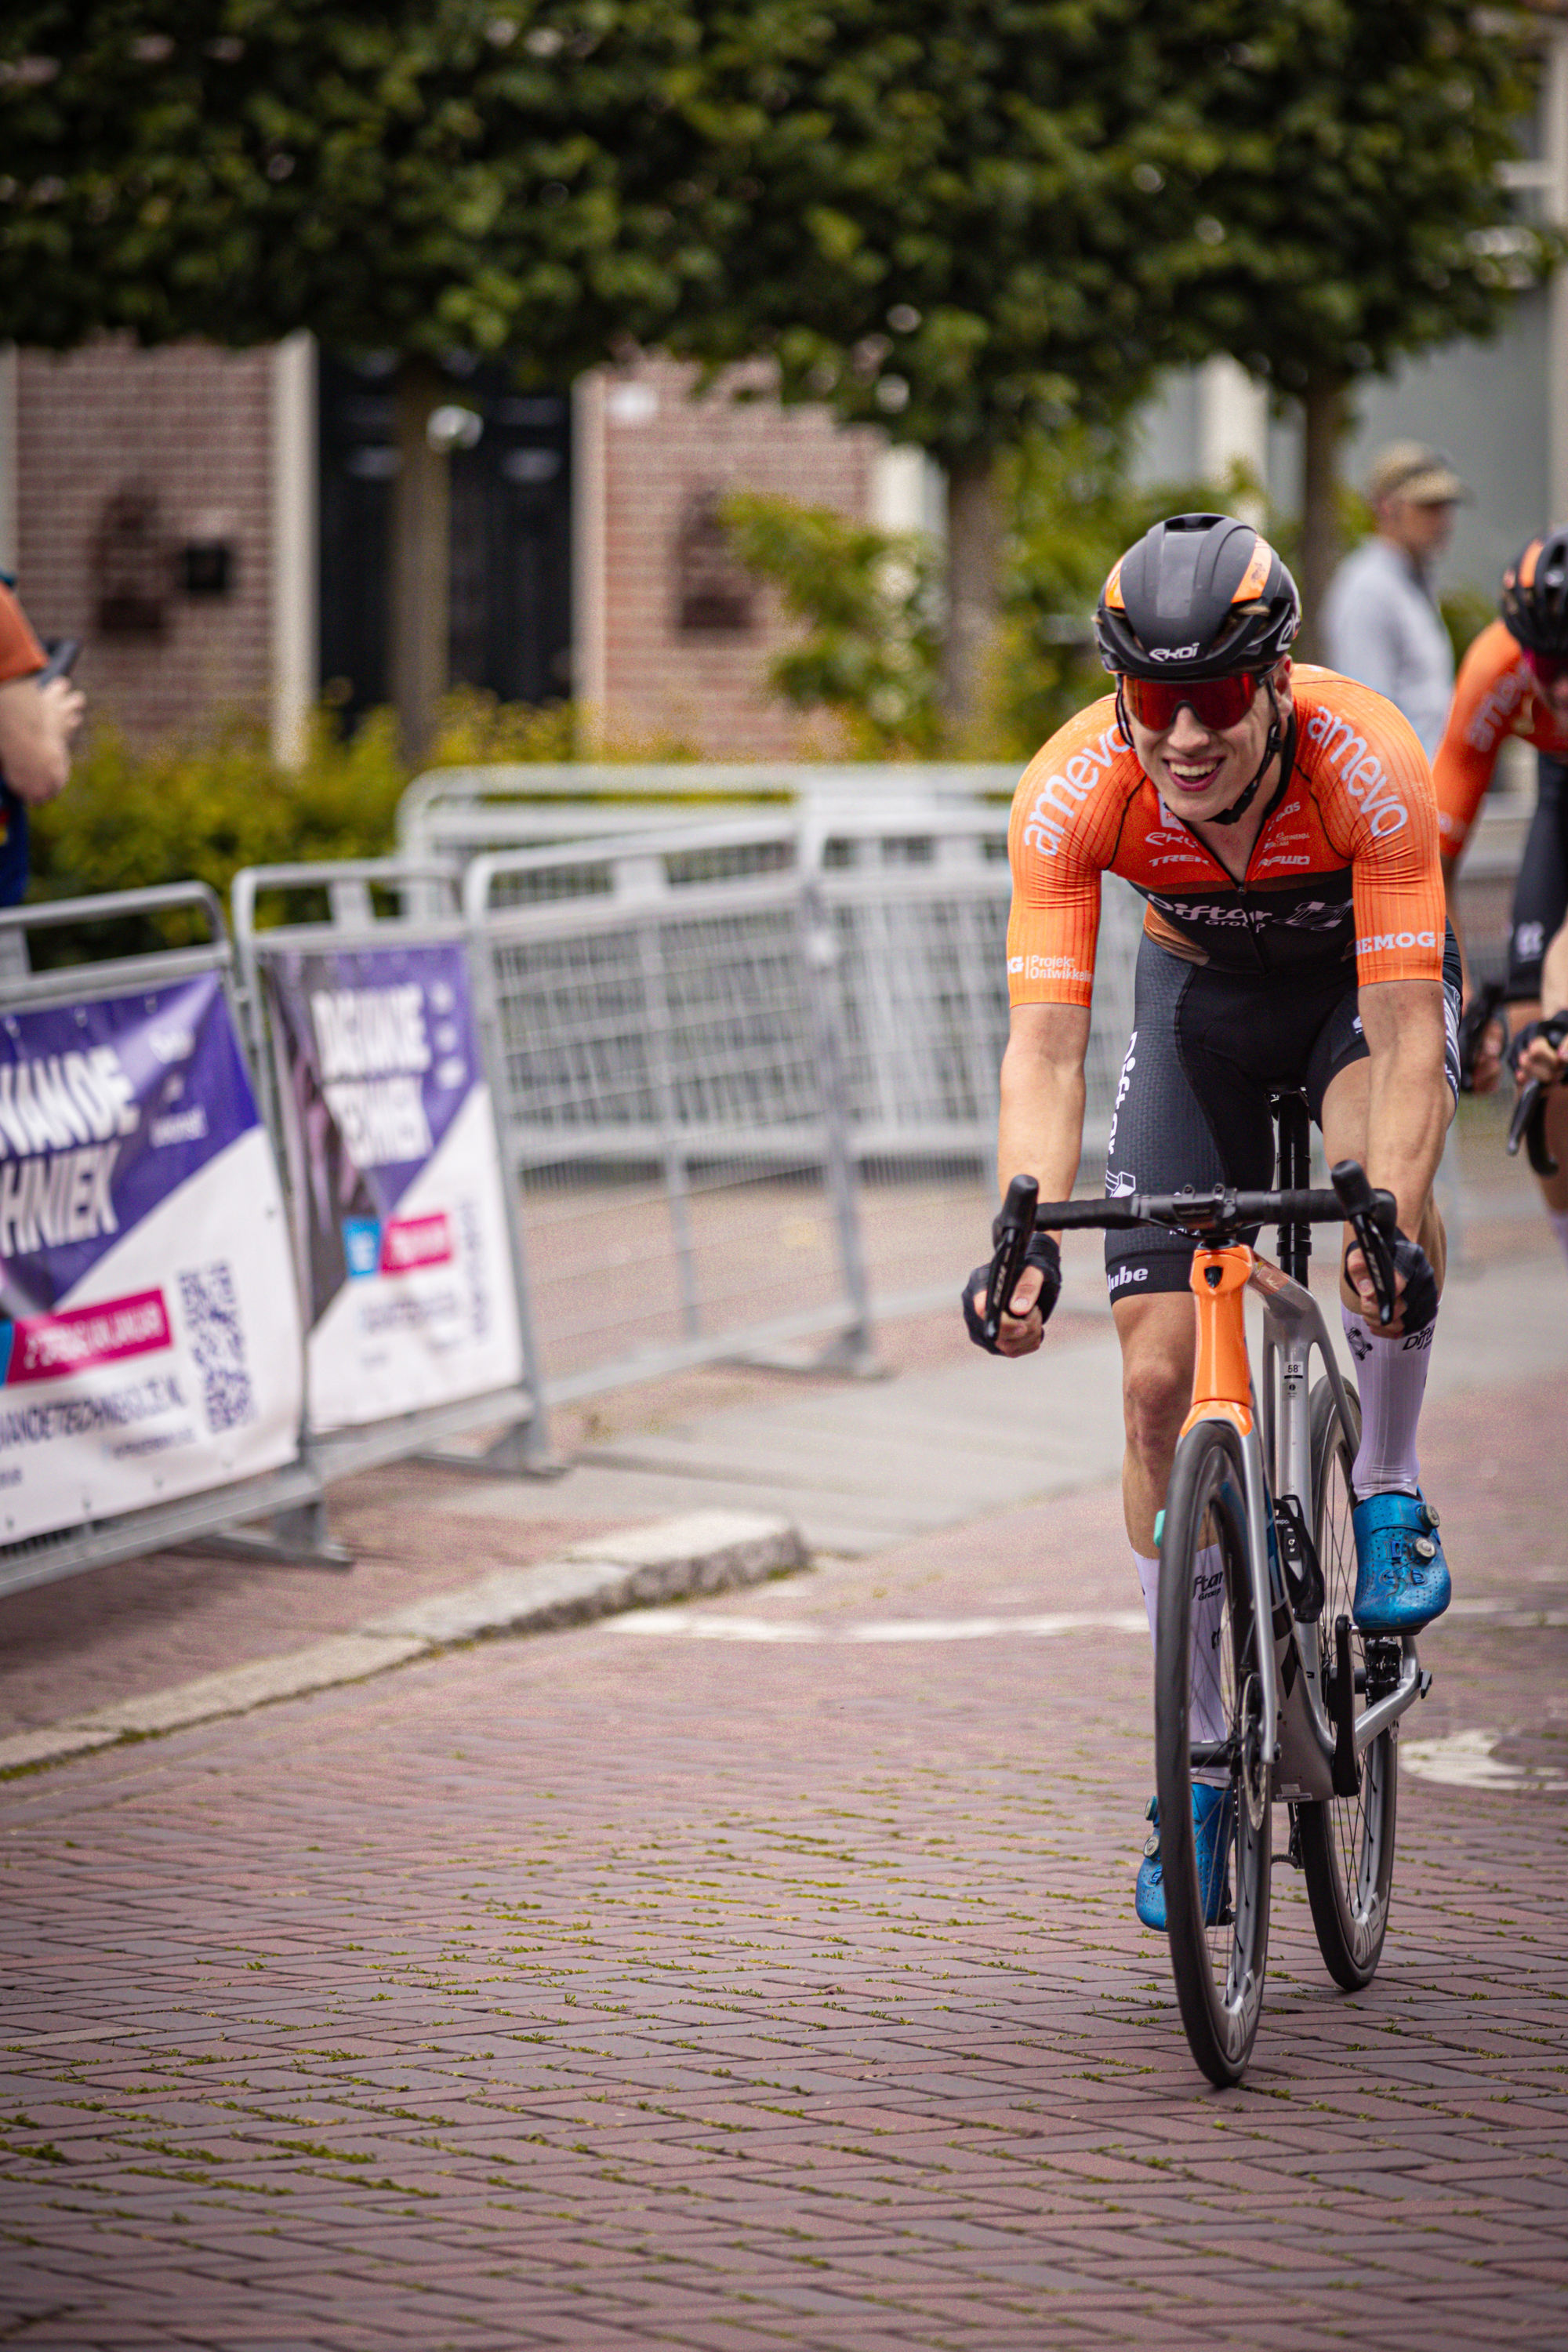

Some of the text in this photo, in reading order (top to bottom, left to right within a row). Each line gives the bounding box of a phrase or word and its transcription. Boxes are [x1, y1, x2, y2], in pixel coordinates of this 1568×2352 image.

[1024, 721, 1131, 856] amevo
[1307, 706, 1408, 837] amevo
[1204, 919, 1266, 934] Group
[1198, 1587, 1221, 1602] Group
